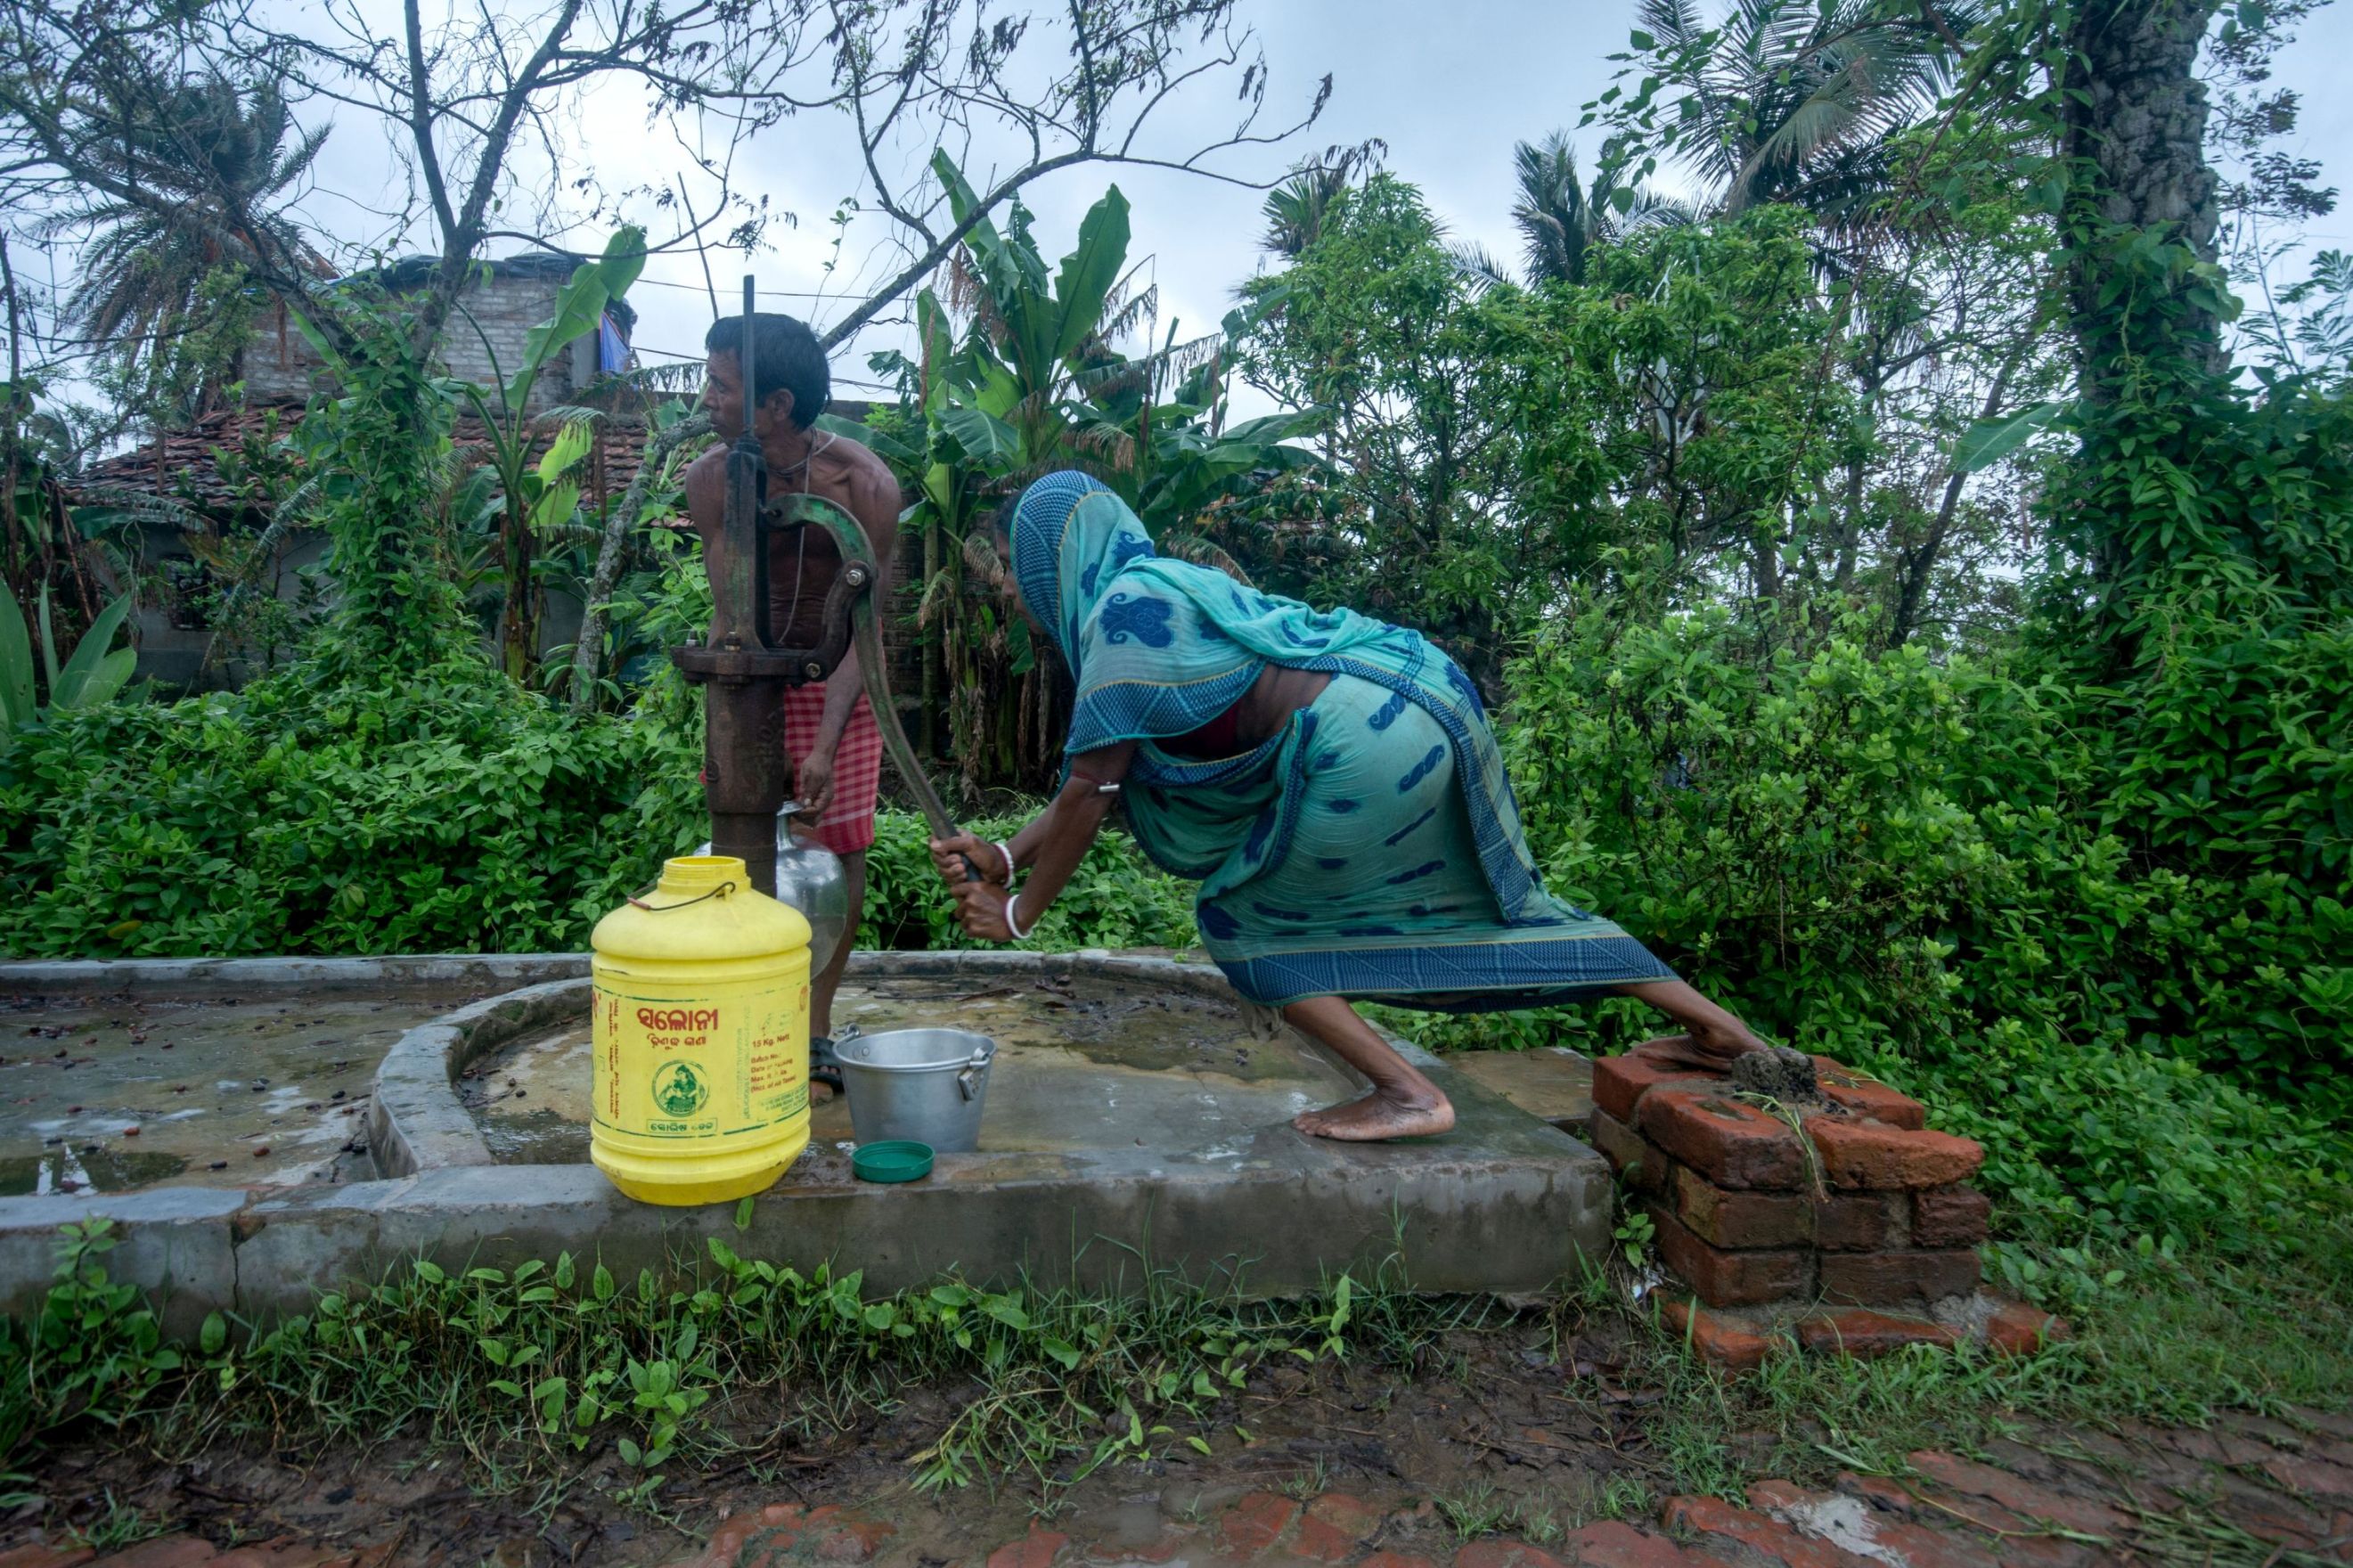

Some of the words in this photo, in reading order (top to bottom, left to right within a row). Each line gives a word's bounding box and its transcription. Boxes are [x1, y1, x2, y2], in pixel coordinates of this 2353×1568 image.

[636, 1008, 718, 1032] ସଲୋନୀ
[752, 1040, 762, 1048] 15
[776, 1033, 790, 1042] Nett
[751, 1066, 765, 1074] Date
